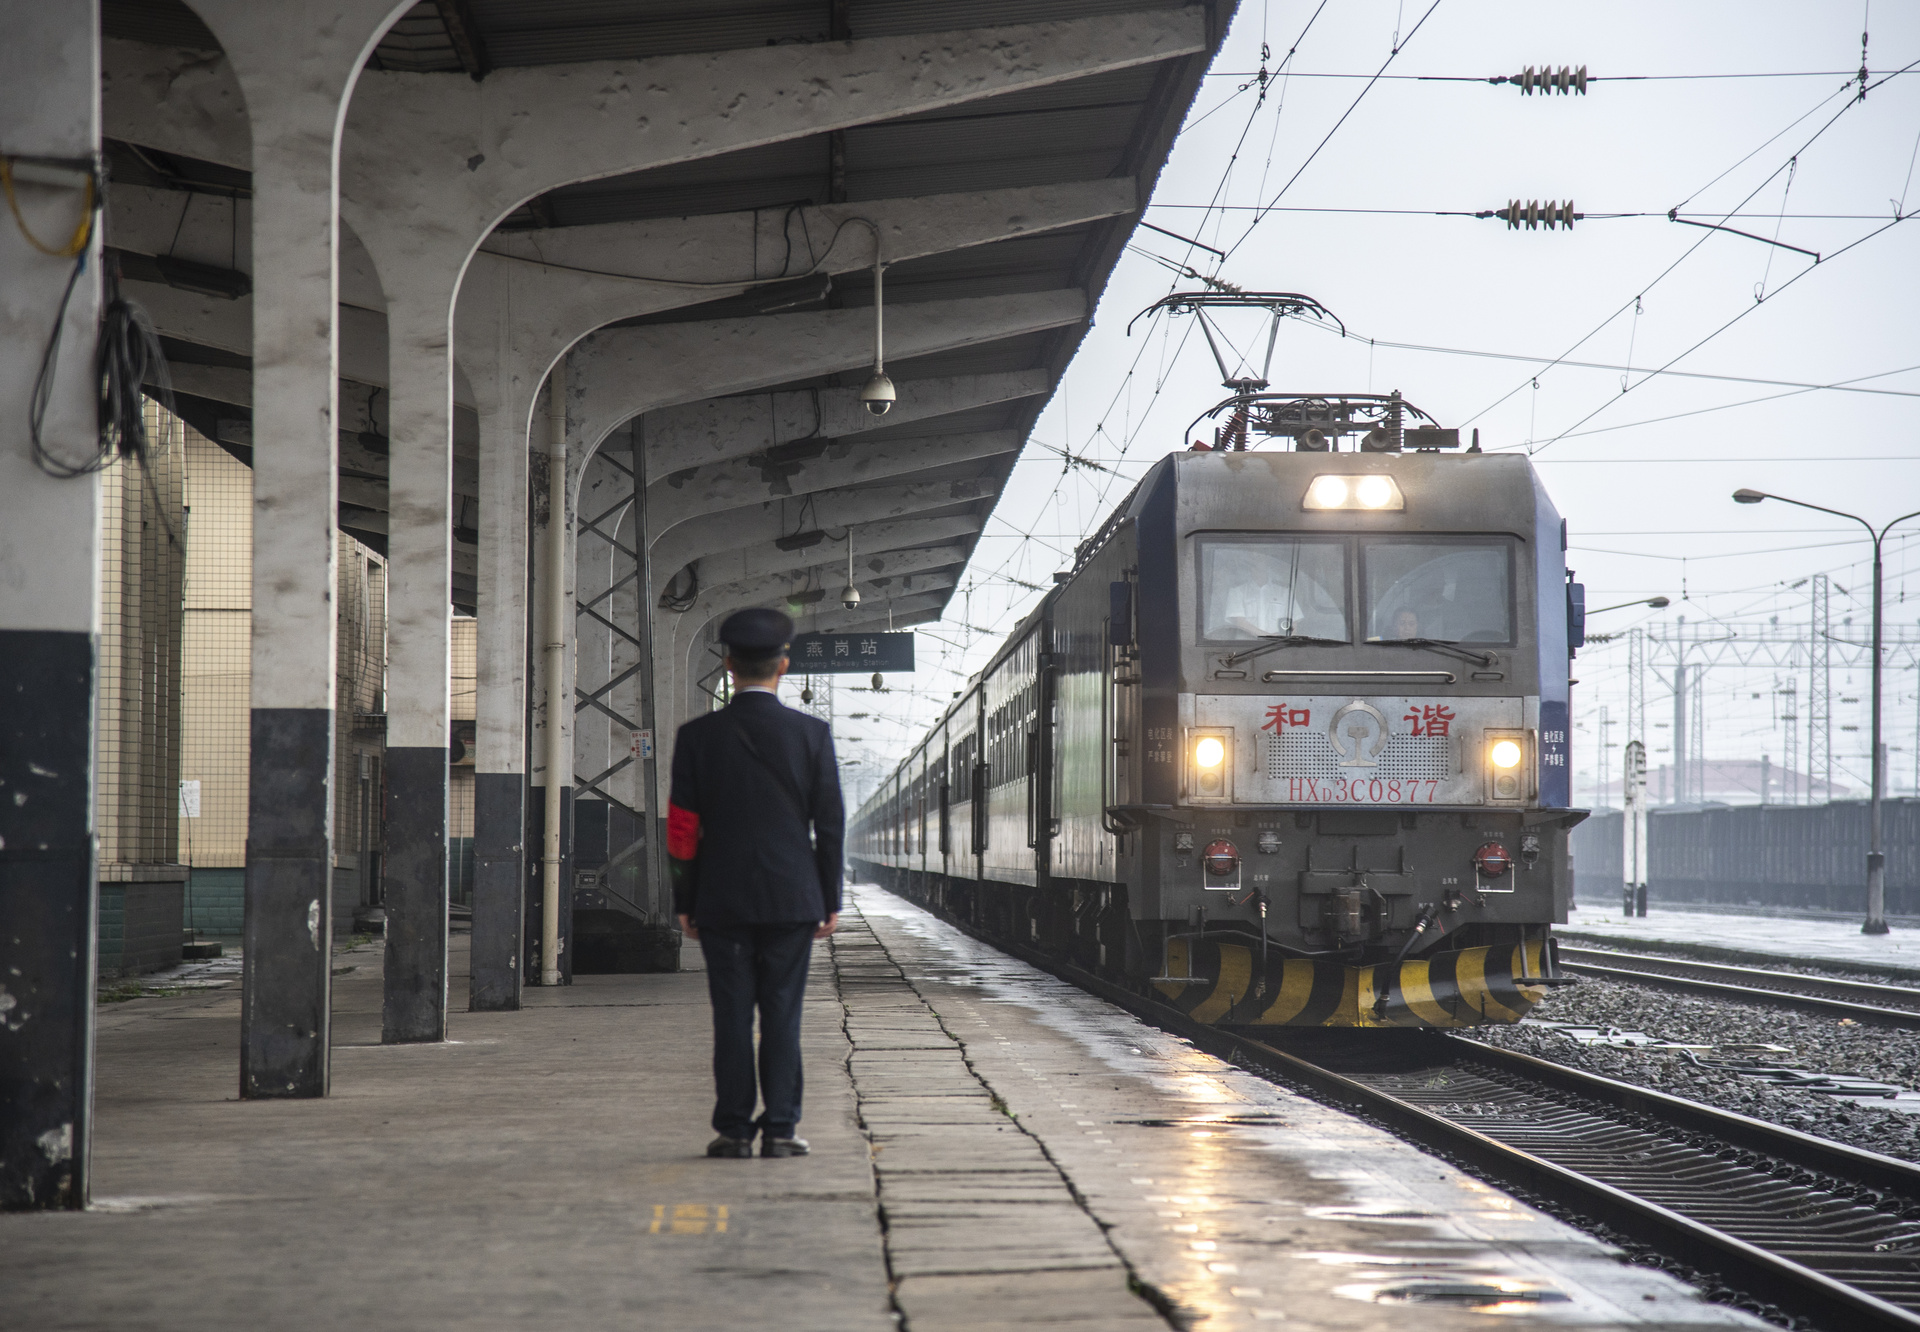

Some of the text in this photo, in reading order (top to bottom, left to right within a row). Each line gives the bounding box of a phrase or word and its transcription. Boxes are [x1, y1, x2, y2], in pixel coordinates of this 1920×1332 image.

[806, 639, 878, 657] 燕岗站
[831, 660, 860, 669] Railway
[864, 659, 890, 667] Station
[1261, 703, 1456, 738] 和 谐
